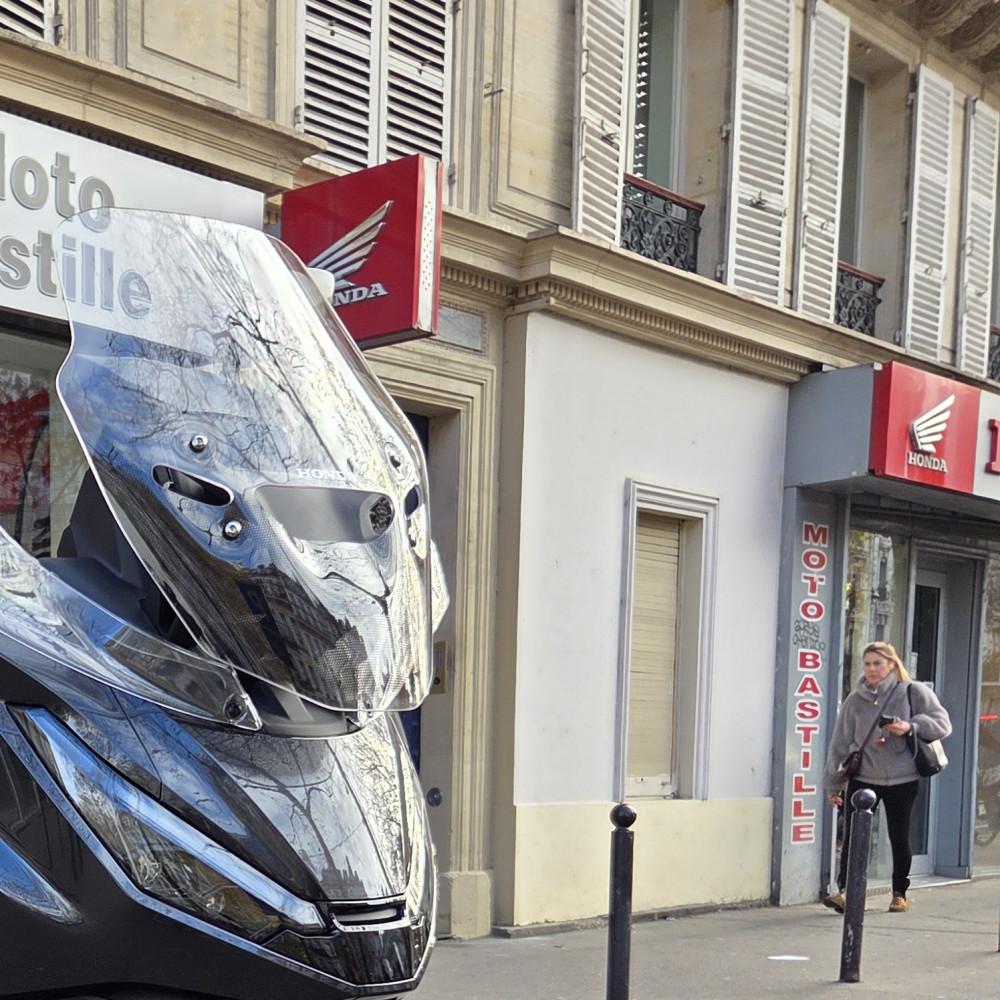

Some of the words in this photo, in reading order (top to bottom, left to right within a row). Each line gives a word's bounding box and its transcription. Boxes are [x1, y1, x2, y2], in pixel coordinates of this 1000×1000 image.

[907, 451, 948, 473] HONDA
[800, 522, 828, 621] MOTO
[791, 650, 822, 844] BASTILLE
